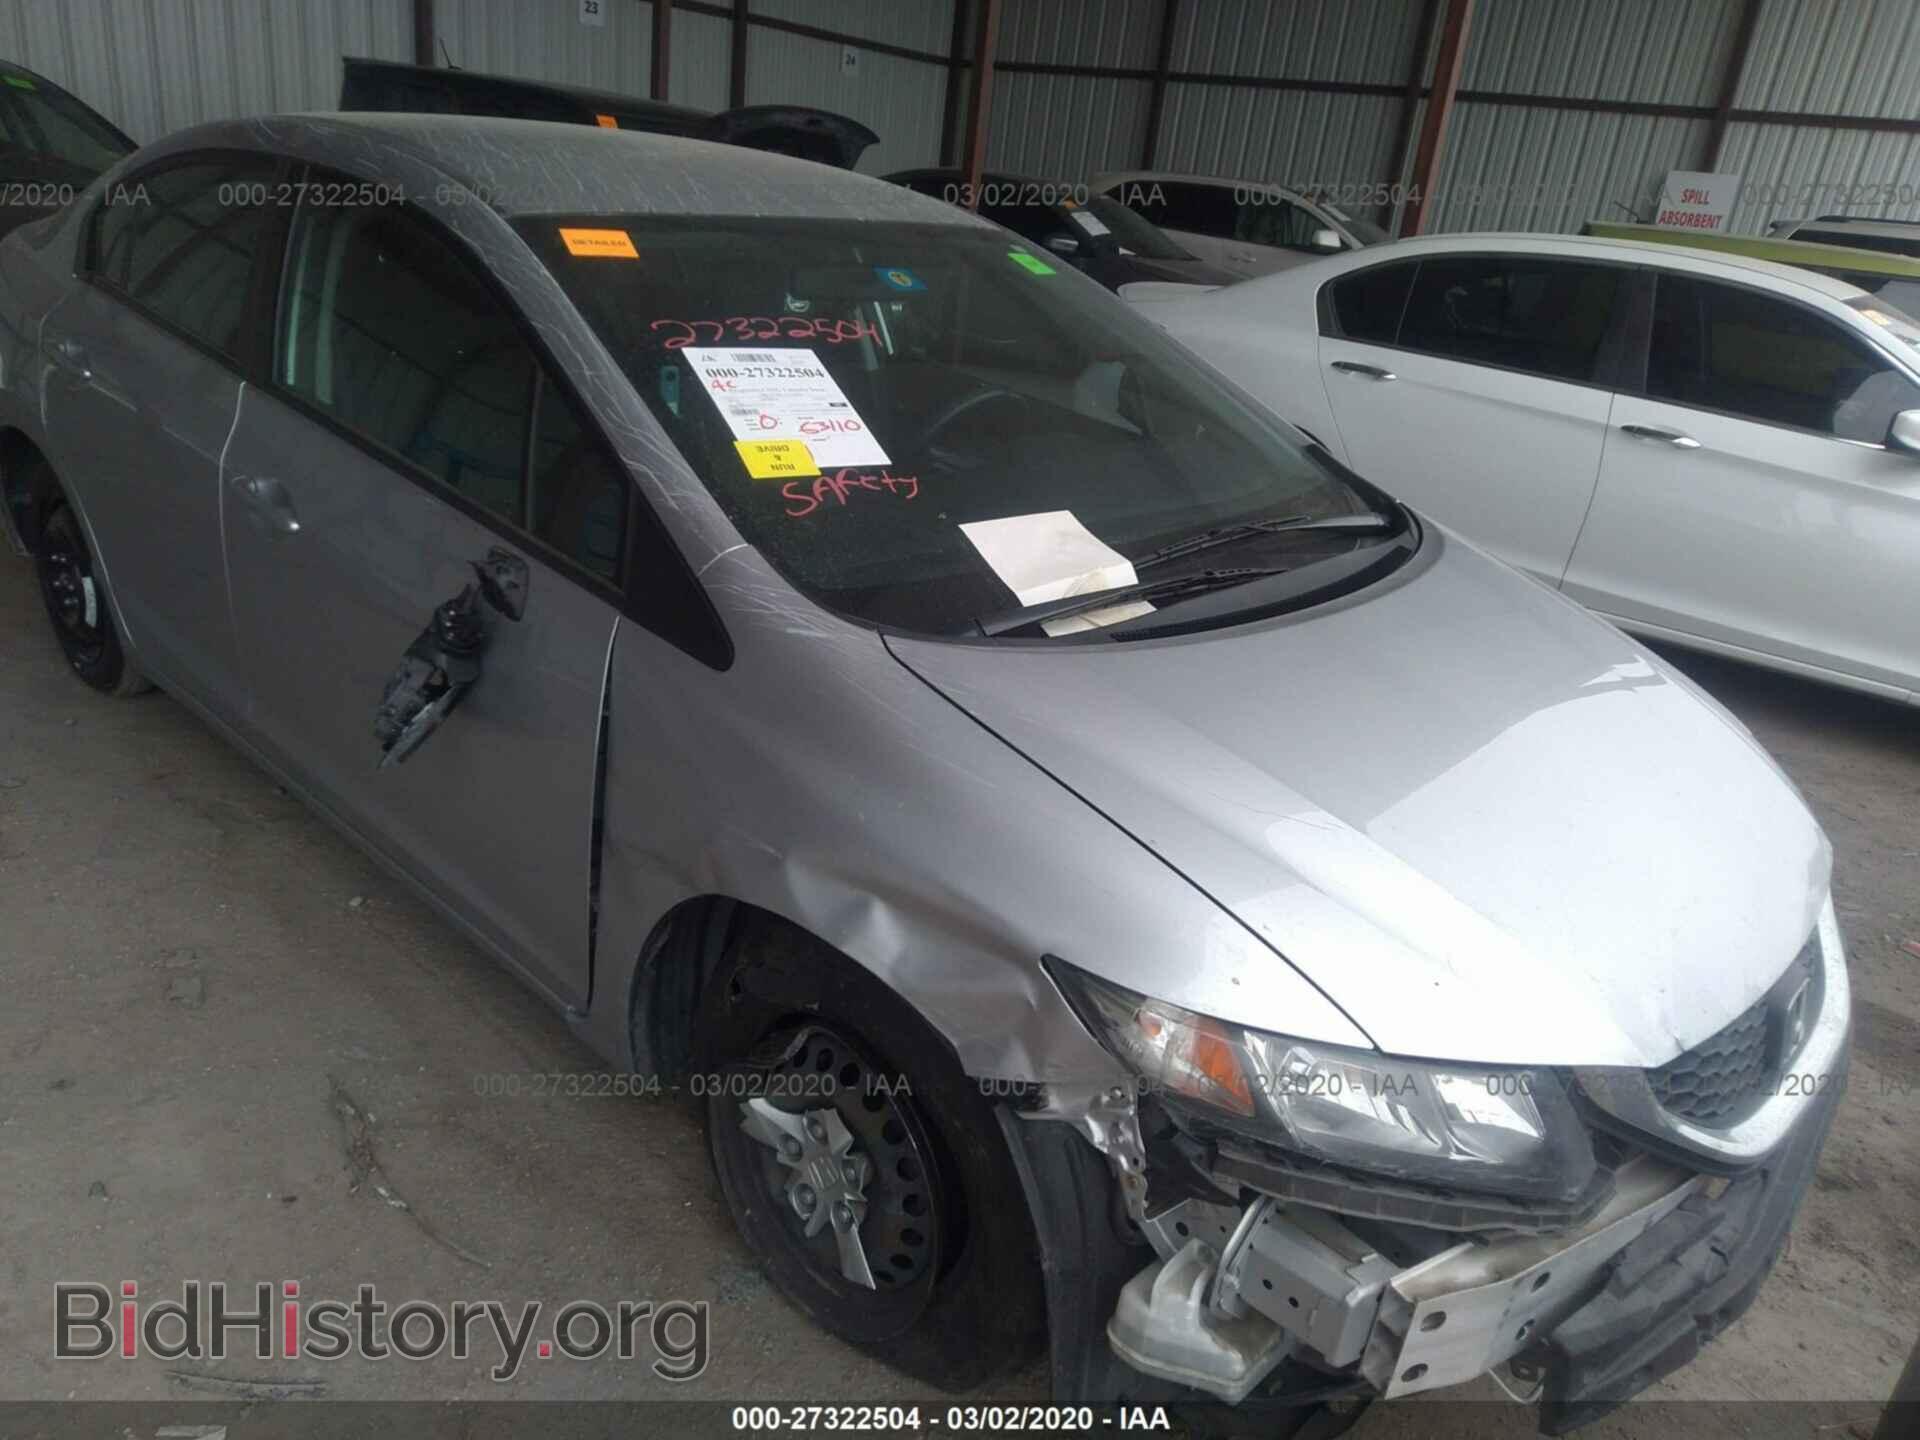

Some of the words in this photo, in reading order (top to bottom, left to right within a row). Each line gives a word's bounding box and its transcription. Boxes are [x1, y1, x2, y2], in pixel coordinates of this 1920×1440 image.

[584, 1, 599, 15] 23
[1681, 187, 1710, 206] SPILL
[1658, 210, 1722, 230] ABSORBENT
[651, 316, 883, 350] 27322504
[705, 367, 825, 379] 000-27322504
